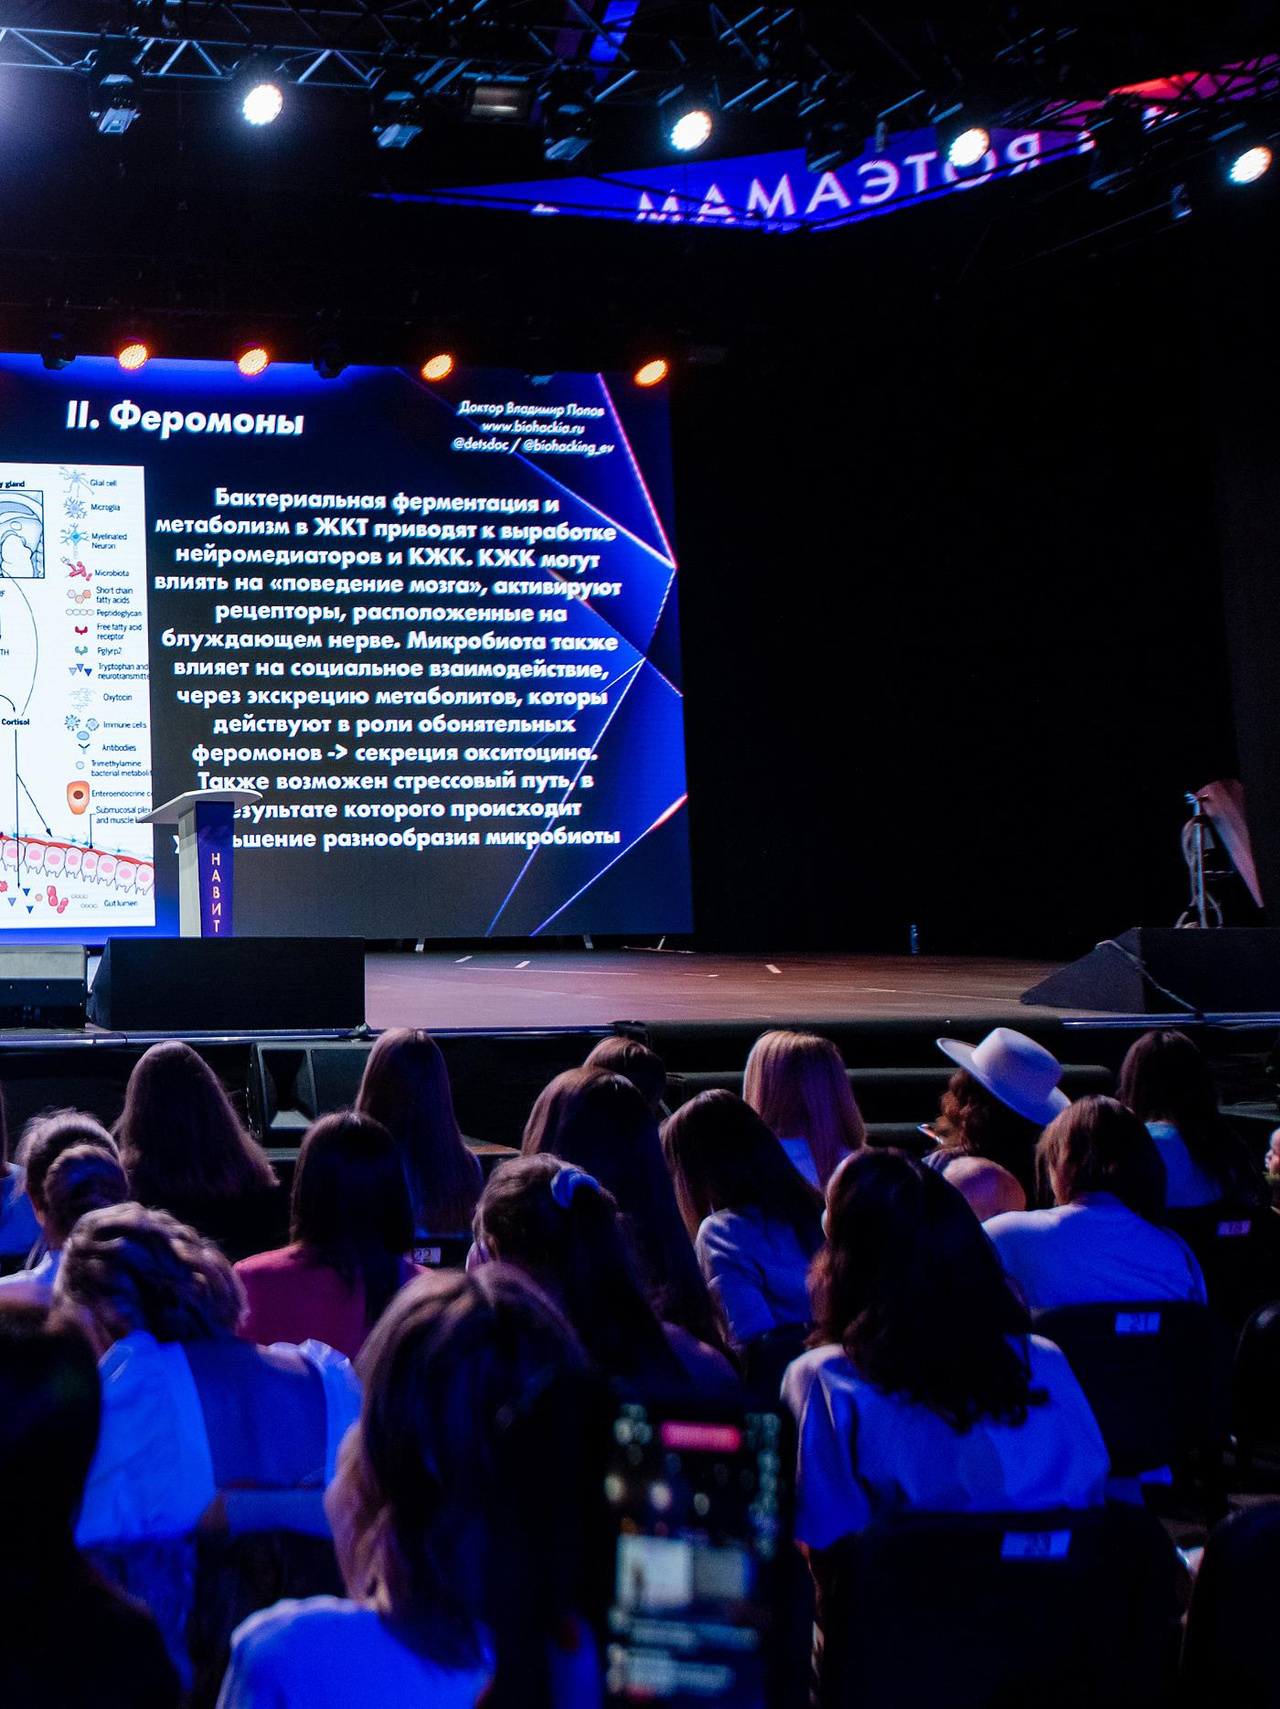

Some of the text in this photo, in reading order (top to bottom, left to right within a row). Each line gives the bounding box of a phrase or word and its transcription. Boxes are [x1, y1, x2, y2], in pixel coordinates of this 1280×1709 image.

[66, 399, 304, 440] II. Феромоны
[457, 400, 605, 419] Доктор Владимир Попов
[452, 437, 509, 451] @detsdoc
[523, 439, 615, 458] @biohacking_ev
[5, 480, 25, 488] gland
[90, 504, 120, 512] Microglia
[215, 488, 559, 515] Бактериальная ферментация и
[92, 533, 127, 542] Myelinated
[155, 515, 617, 545] метаболизм в ЖКТ приводят к выработке
[176, 543, 600, 573] нейромедиаторов и КЖК. КЖК могут
[96, 586, 115, 594] Short
[154, 576, 622, 600] влиять на «поведение мозга», активируют
[96, 596, 111, 604] fatty
[96, 609, 142, 618] Peptidoglycan
[215, 604, 568, 626] рецепторы, расположенные на
[112, 624, 126, 632] fatty
[161, 628, 618, 654] блуждающем нерве. Микробиота также
[98, 662, 134, 671] Tryptophan
[173, 659, 609, 681] влияет на социальное взаимодействие,
[103, 694, 132, 702] Oxytocin
[176, 686, 608, 711] через экскрецию метаболитов, которы
[1, 718, 30, 726] Cortisol
[213, 714, 577, 738] действуют в роли обонятельных
[102, 744, 136, 752] Antibodies
[192, 744, 322, 766] феромонов
[354, 747, 458, 766] секреция
[464, 747, 598, 763] окситоцина.
[91, 760, 142, 768] Trimethylamine
[197, 770, 594, 794] Также возможен стрессовый путь, в
[96, 806, 136, 814] Submucosal
[233, 802, 582, 824] езультате которого происходит
[324, 827, 480, 852] разнообразия
[486, 826, 621, 850] микробиоты
[211, 852, 222, 933] НАВИТ
[104, 900, 116, 908] Gut
